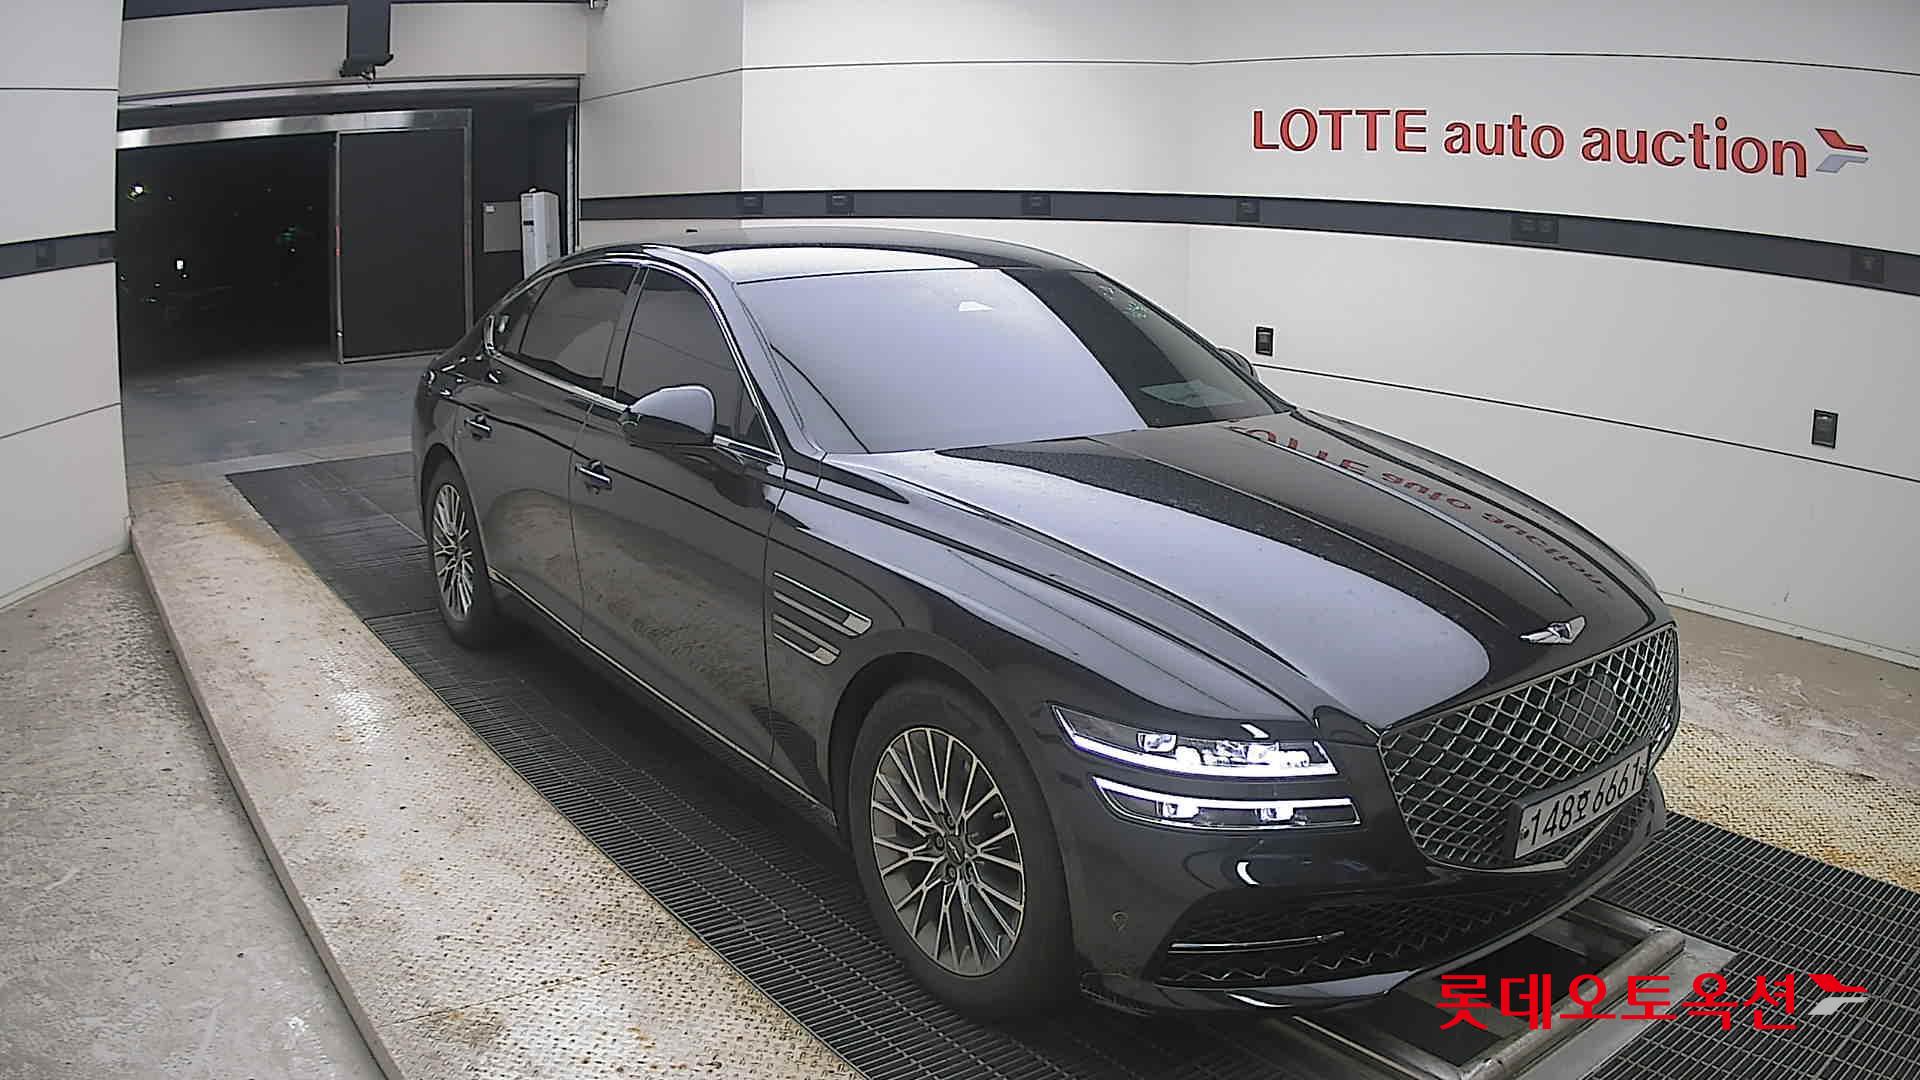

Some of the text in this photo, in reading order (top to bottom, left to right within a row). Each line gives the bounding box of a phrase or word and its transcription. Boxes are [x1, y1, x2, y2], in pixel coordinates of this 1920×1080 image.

[1252, 108, 1808, 178] LOTTE auto auction
